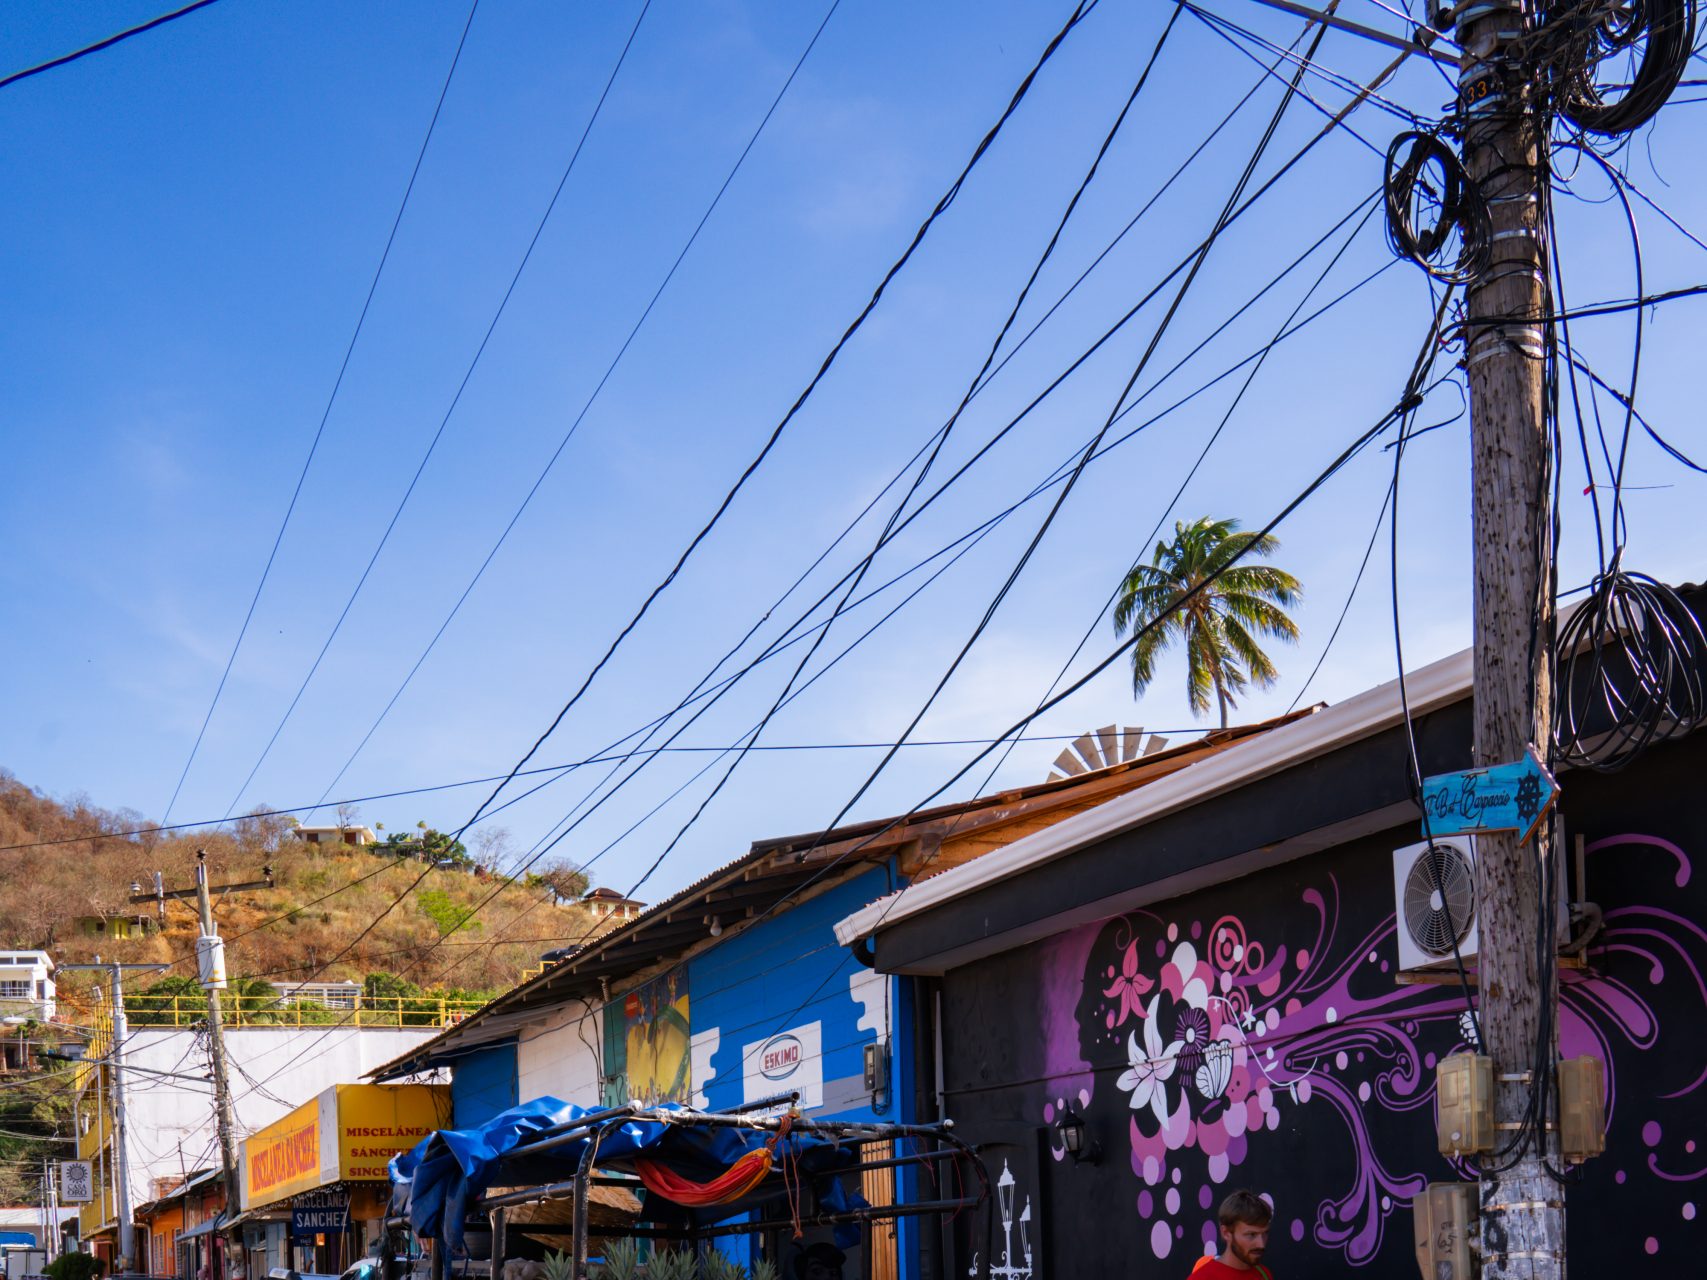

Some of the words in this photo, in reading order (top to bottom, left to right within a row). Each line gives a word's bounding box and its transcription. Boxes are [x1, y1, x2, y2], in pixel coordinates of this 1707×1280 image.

[764, 1045, 799, 1070] ESKIMO
[346, 1124, 431, 1137] MISCELÁNEA
[296, 1212, 347, 1228] SANCHEZ
